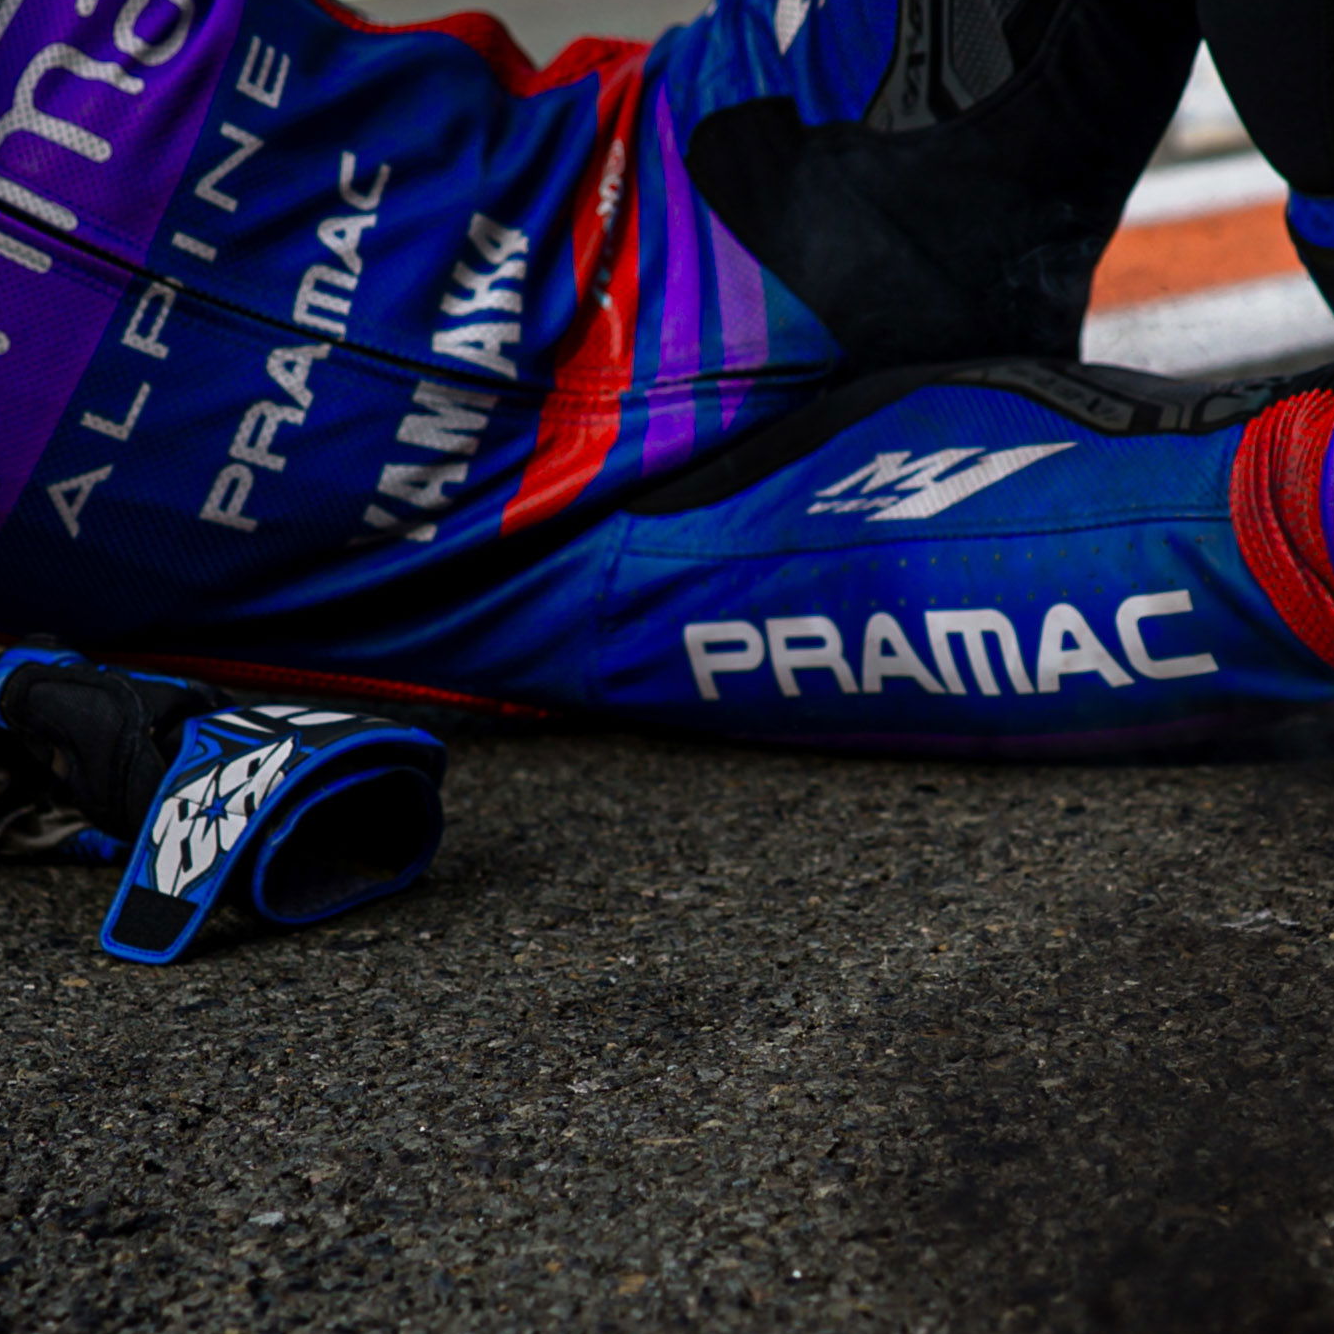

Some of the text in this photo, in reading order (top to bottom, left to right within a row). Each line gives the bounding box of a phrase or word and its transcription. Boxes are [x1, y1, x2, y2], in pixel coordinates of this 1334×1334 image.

[46, 35, 292, 538] ALPINE
[199, 151, 391, 534] PRAMAC
[349, 212, 529, 547] YAMAHA
[683, 589, 1219, 701] PRAMAC
